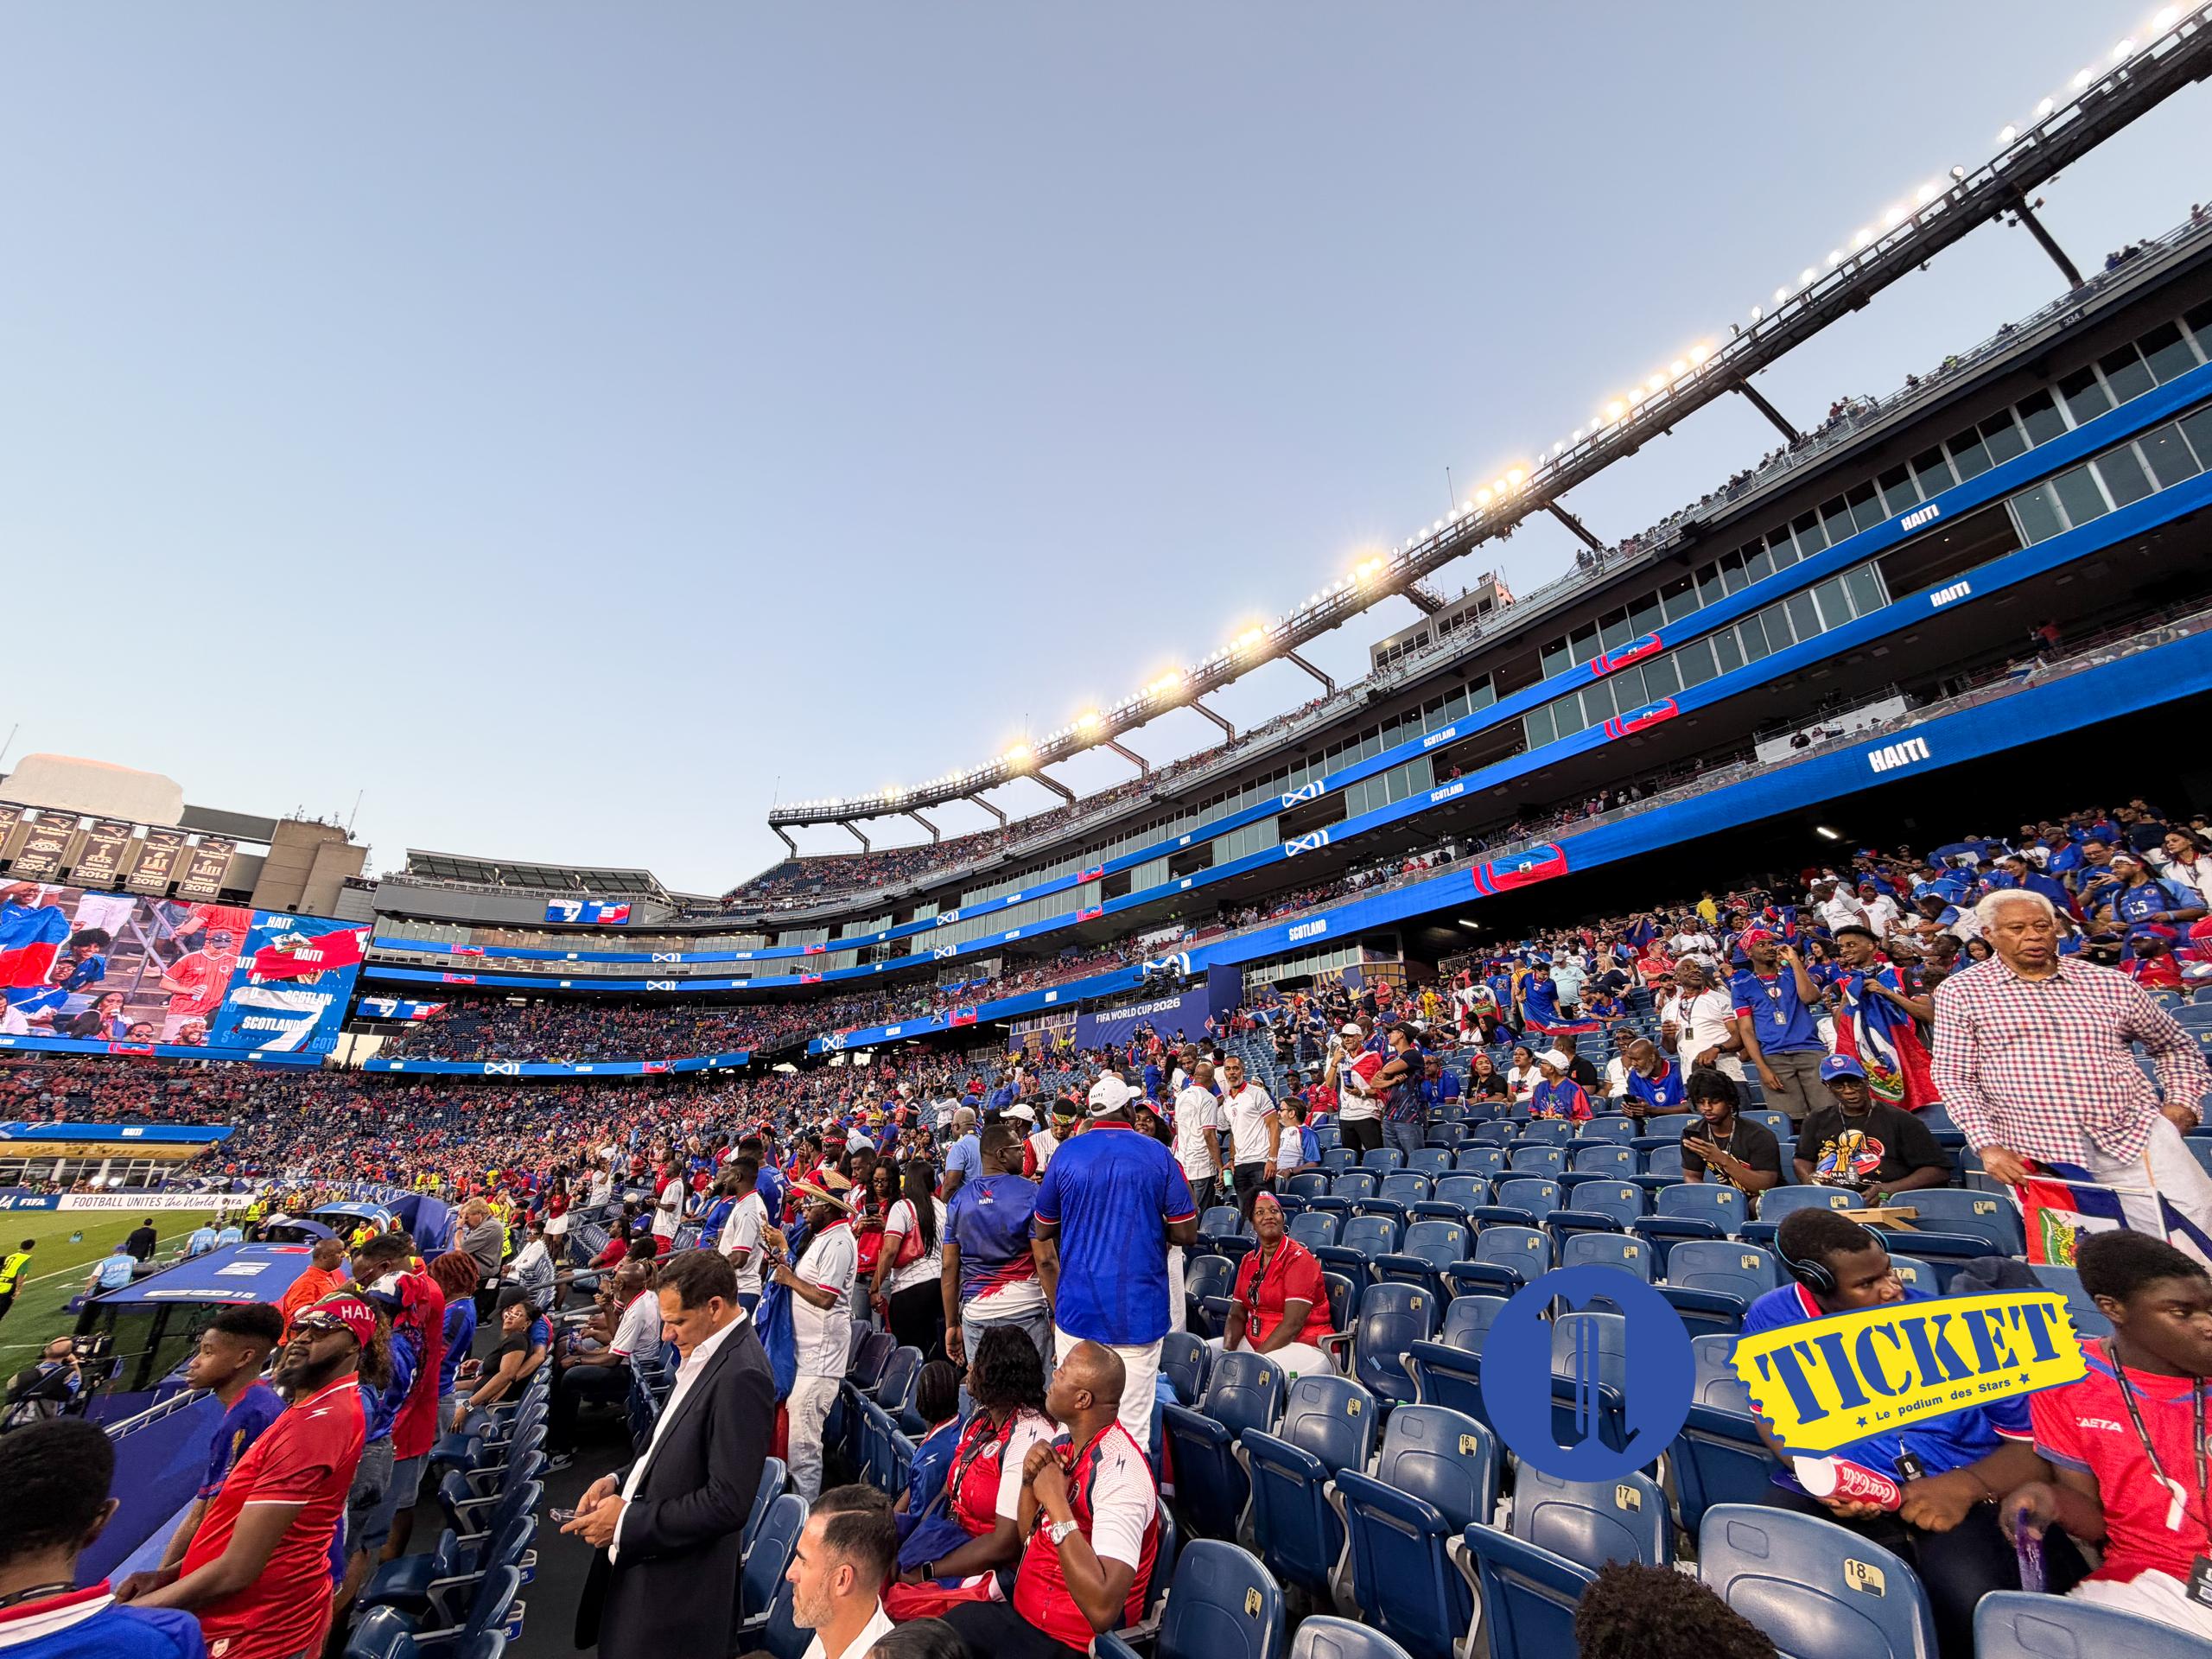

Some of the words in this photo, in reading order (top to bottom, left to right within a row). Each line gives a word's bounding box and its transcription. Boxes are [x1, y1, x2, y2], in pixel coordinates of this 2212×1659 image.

[1901, 504, 1940, 531] HAITI
[1929, 581, 1971, 607] HAITI
[1423, 727, 1456, 748] SCOTLAND
[1868, 737, 1929, 772] HAITI
[1430, 783, 1465, 803] SCOTLAND
[76, 870, 110, 880] 2014
[131, 878, 163, 887] 2016
[1289, 918, 1326, 942] SCOTLAND
[293, 949, 323, 962] HAITI
[1096, 1013, 1111, 1024] FIFA
[1111, 1007, 1137, 1021] WORLD
[1137, 1004, 1153, 1016] CUP
[1153, 997, 1181, 1013] 2026
[242, 1016, 302, 1032] SCOTLAND
[73, 1197, 124, 1208] FOOTBALL
[127, 1197, 162, 1207] UNITES
[164, 1196, 182, 1207] the
[184, 1195, 217, 1207] World
[1349, 1399, 1357, 1409] 15
[1461, 1435, 1470, 1446] 16
[1618, 1485, 1630, 1499] 17
[1847, 1560, 1866, 1580] 18
[1248, 1587, 1256, 1605] 16
